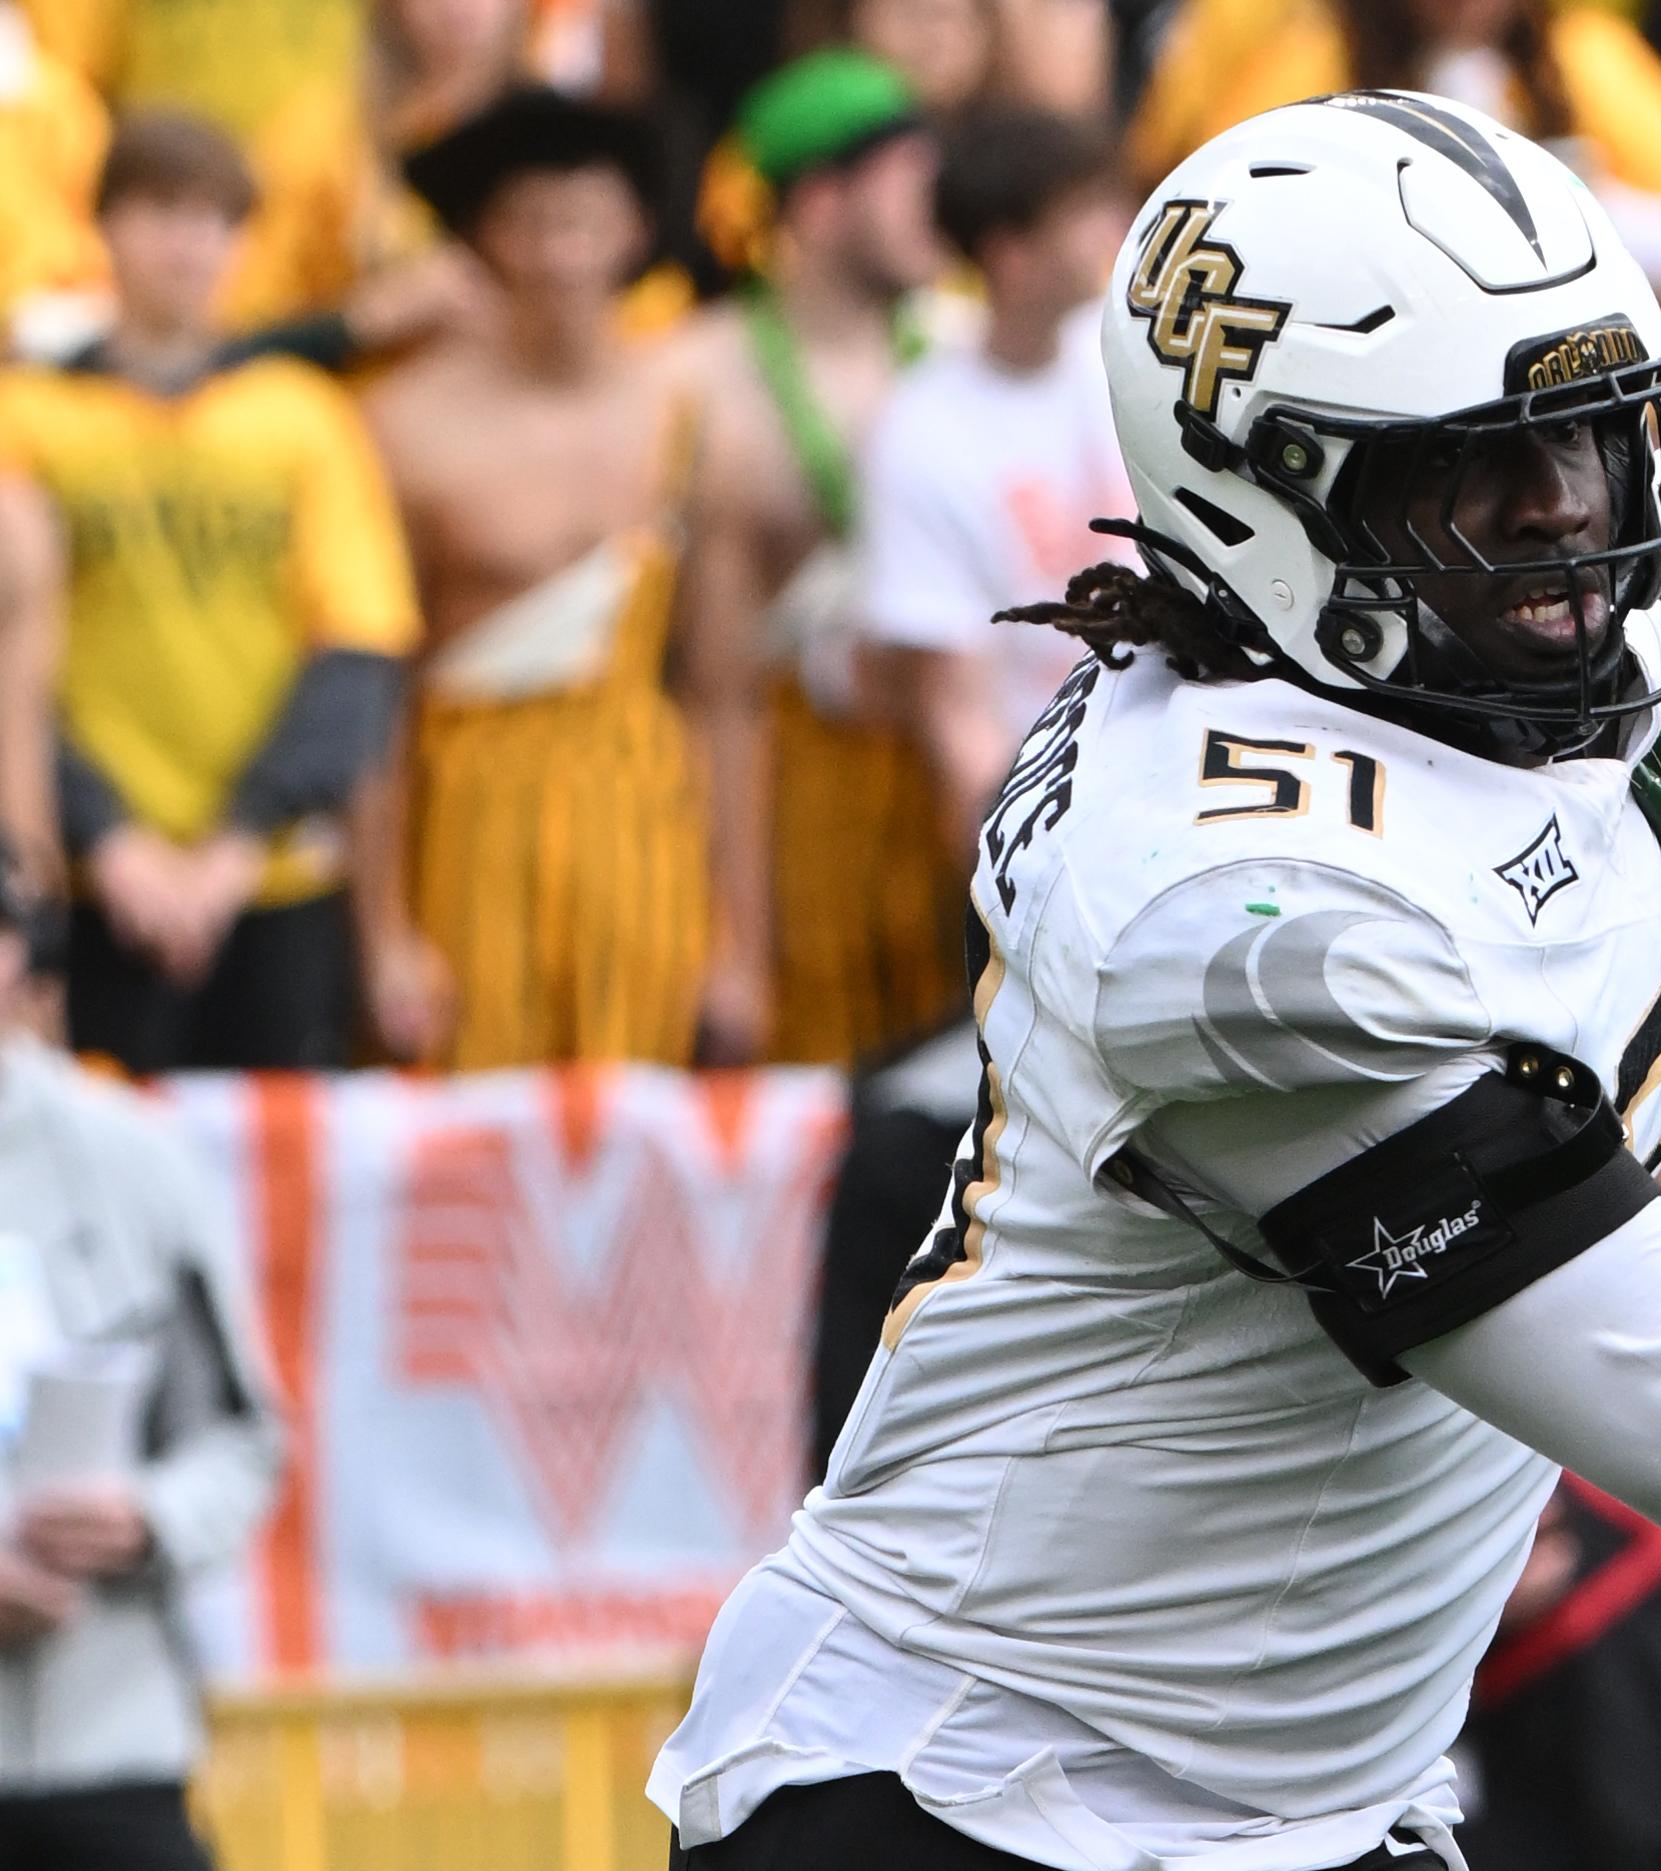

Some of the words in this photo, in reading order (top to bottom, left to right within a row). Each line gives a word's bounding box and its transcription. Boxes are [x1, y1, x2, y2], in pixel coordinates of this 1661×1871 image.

[1128, 199, 1293, 420] UCF
[1527, 327, 1644, 390] ORLNDO
[1194, 728, 1387, 841] 51
